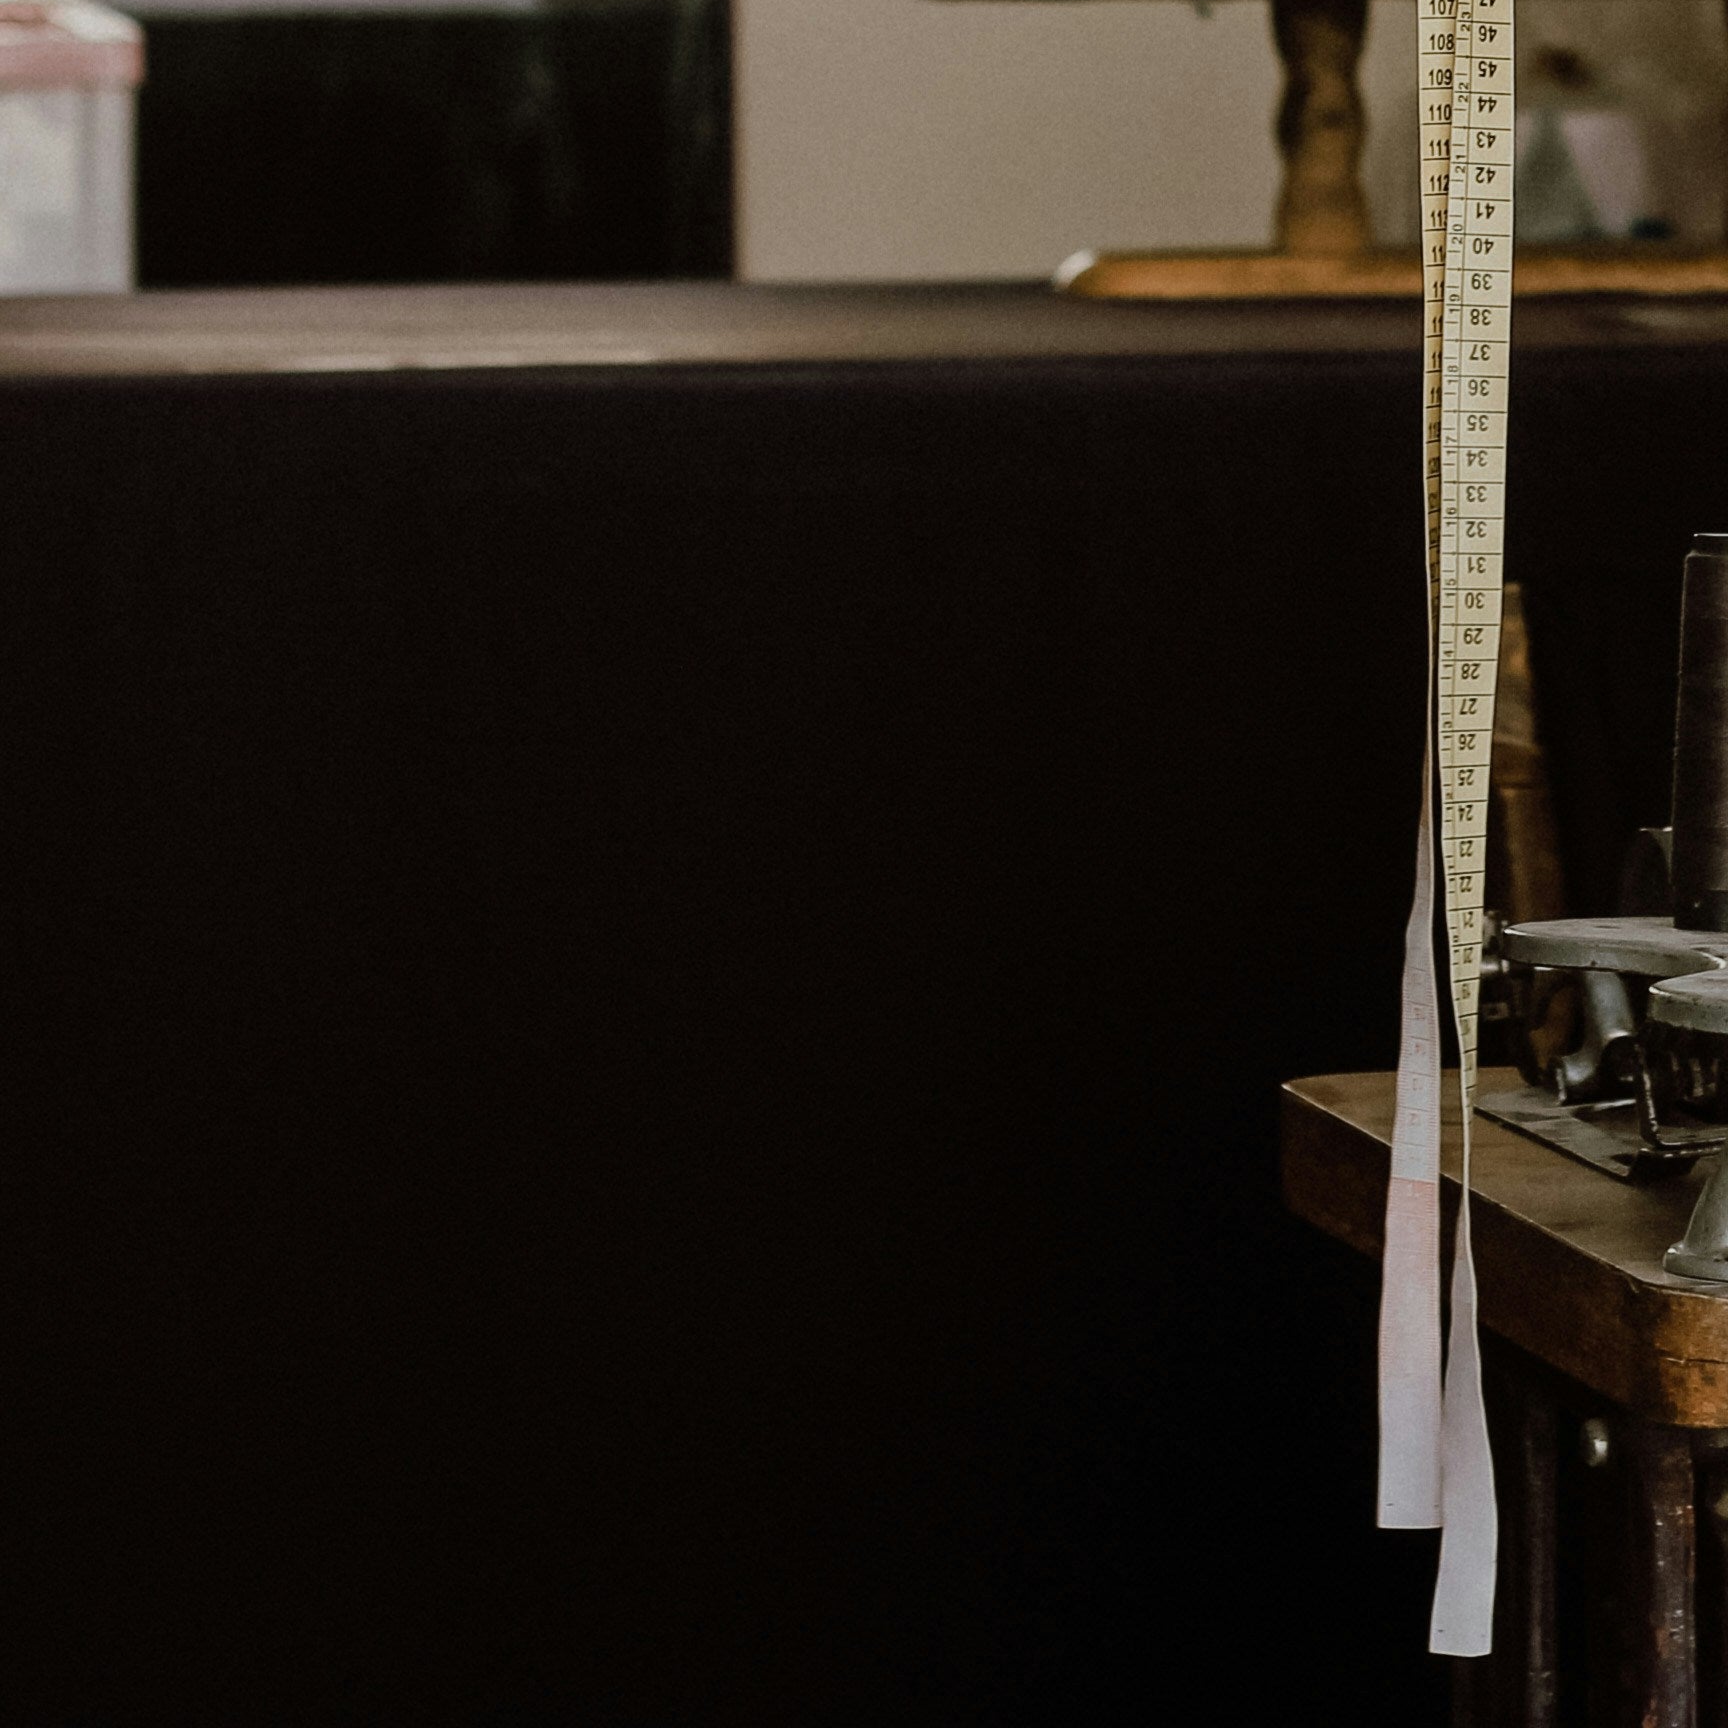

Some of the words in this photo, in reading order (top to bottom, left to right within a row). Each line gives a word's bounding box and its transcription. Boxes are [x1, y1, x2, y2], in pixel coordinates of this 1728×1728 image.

[1430, 33, 1454, 51] 108
[1478, 25, 1498, 43] 46
[1429, 69, 1453, 86] 109
[1478, 60, 1497, 78] 45
[1429, 104, 1452, 121] 110
[1477, 96, 1497, 113] 44
[1429, 139, 1450, 156] 111
[1476, 131, 1496, 149] 43
[1430, 174, 1449, 192] 112
[1475, 166, 1496, 184] 42
[1476, 202, 1495, 219] 41
[1472, 238, 1494, 255] 40
[1471, 273, 1492, 291] 39
[1470, 308, 1491, 326] 38
[1469, 344, 1491, 361] 37
[1468, 379, 1490, 397] 36
[1467, 414, 1489, 432] 35
[1466, 450, 1488, 467] 34
[1466, 485, 1488, 503] 33
[1466, 521, 1487, 538] 32
[1467, 556, 1487, 574] 31
[1465, 592, 1485, 609] 30
[1463, 627, 1484, 645] 29
[1461, 663, 1481, 680] 28
[1459, 698, 1478, 715] 27
[1459, 733, 1476, 751] 26
[1458, 769, 1474, 786] 25
[1458, 804, 1474, 822] 24
[1460, 840, 1473, 857] 23
